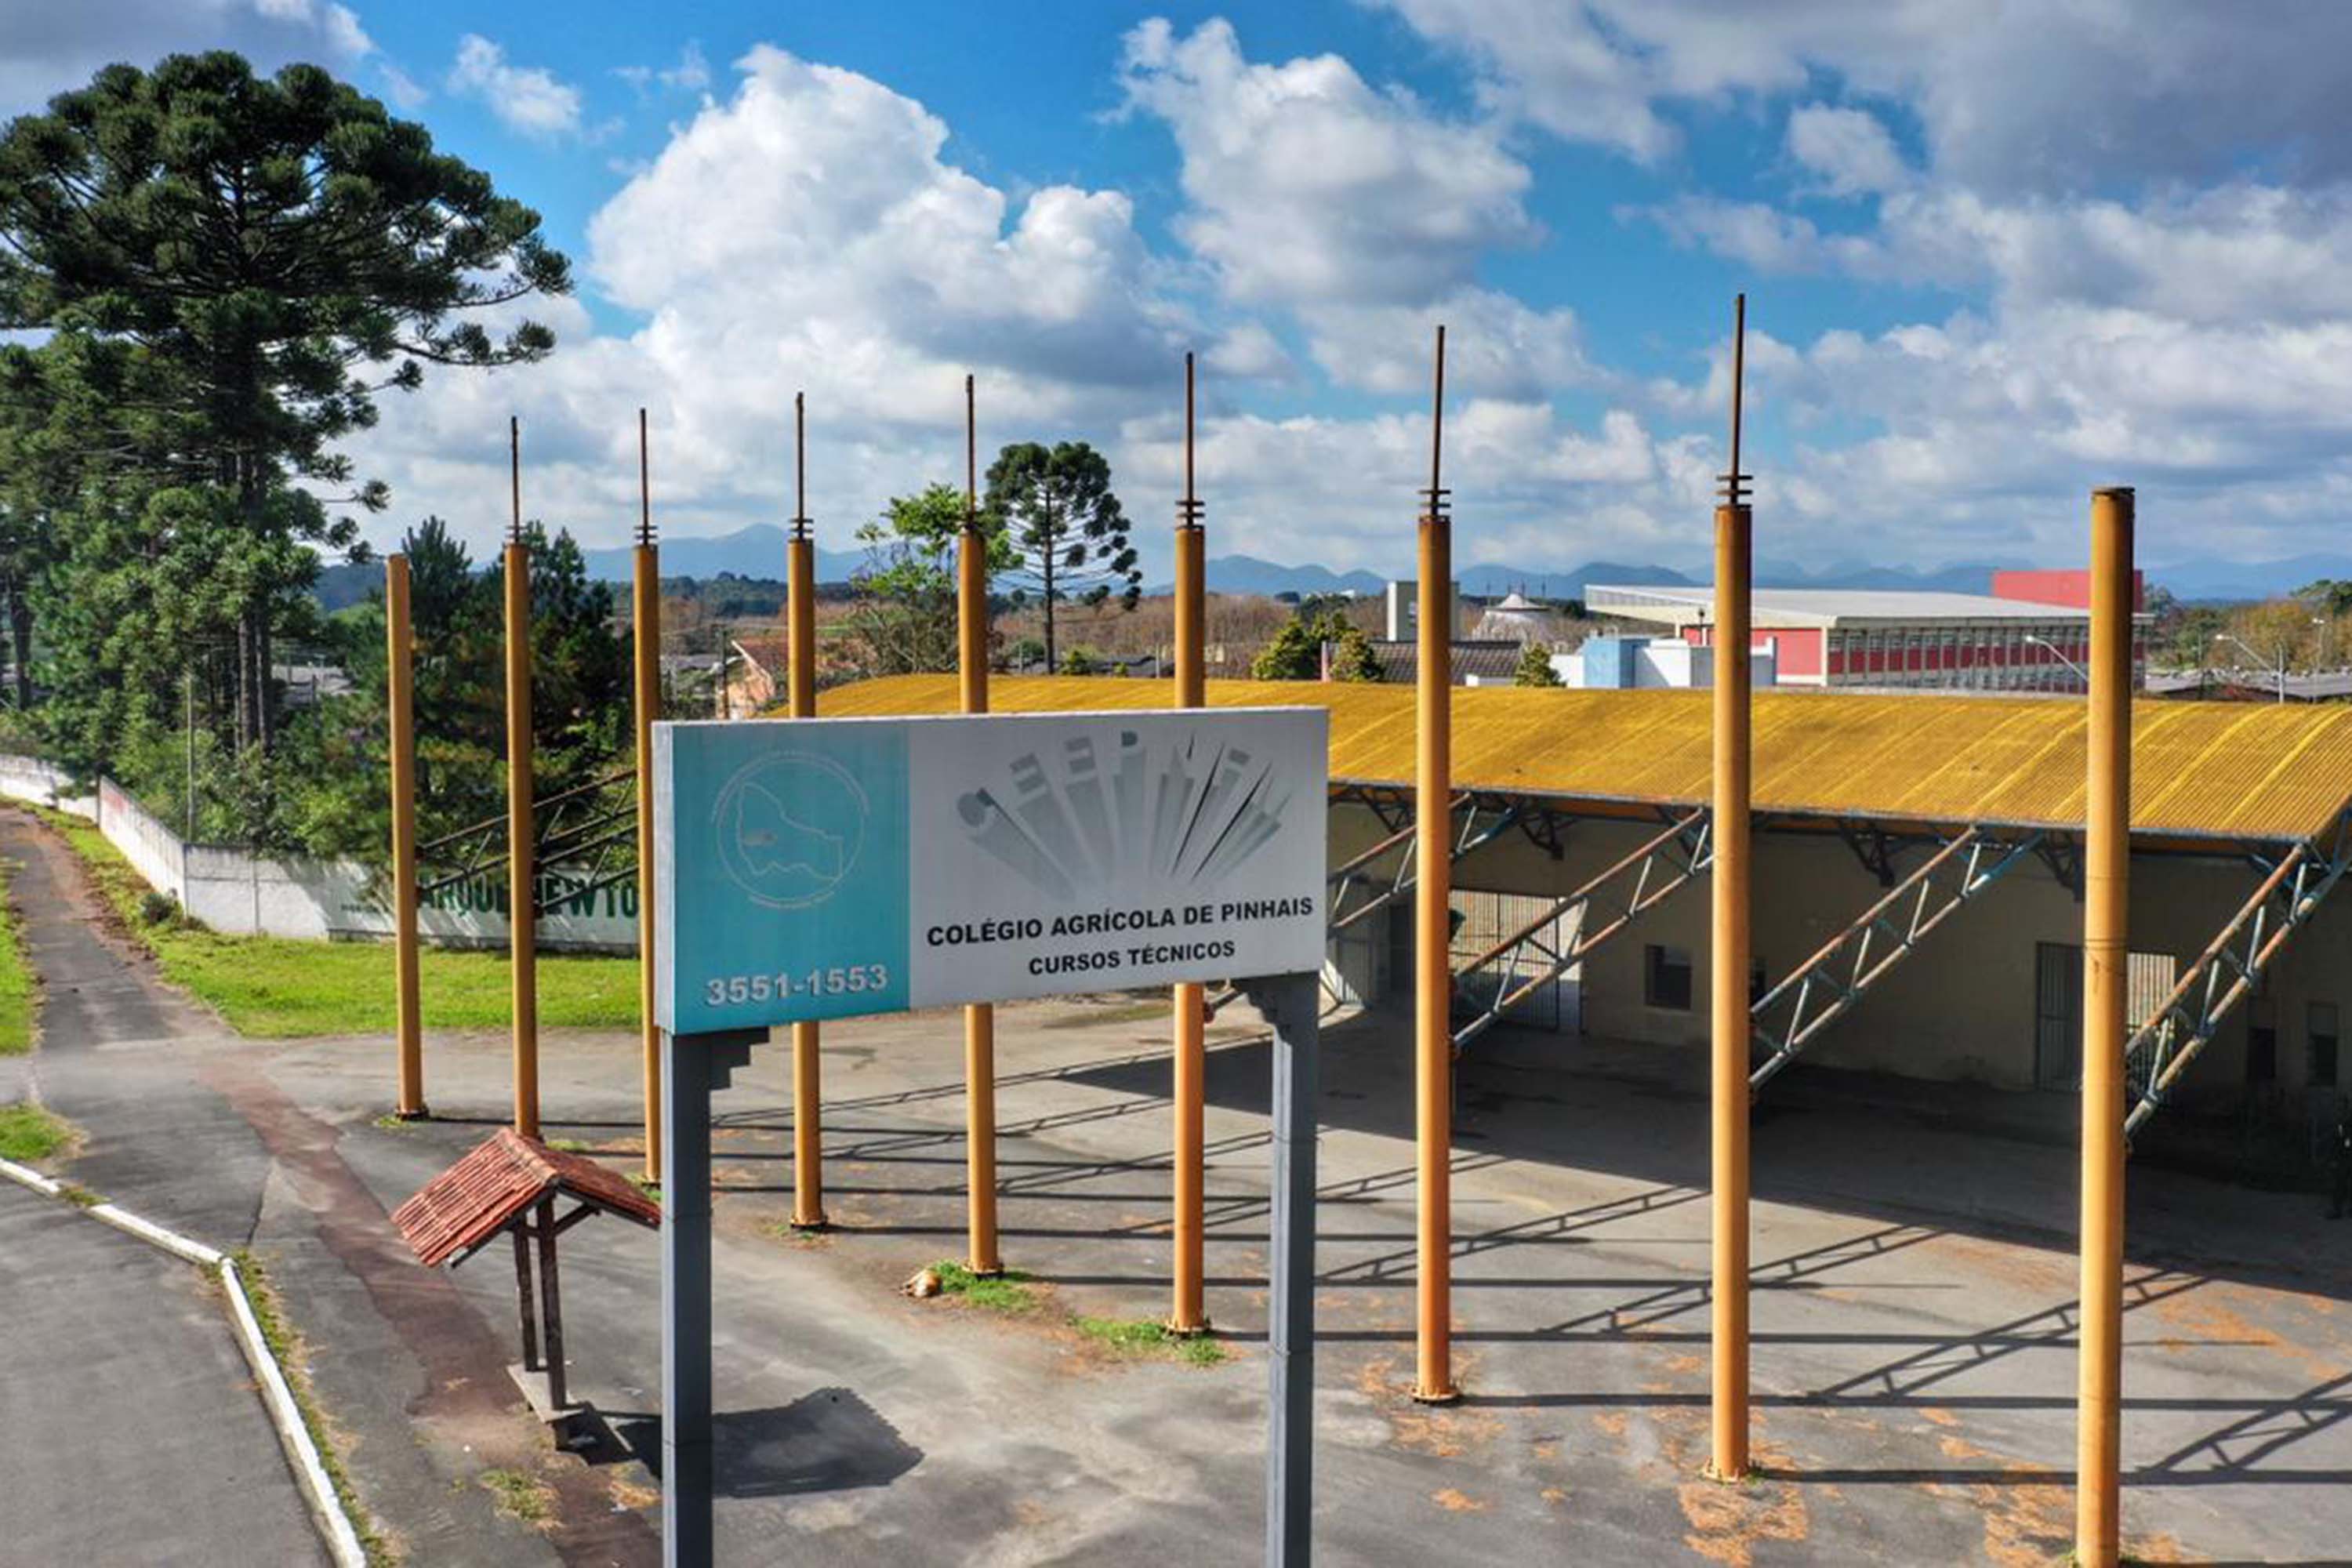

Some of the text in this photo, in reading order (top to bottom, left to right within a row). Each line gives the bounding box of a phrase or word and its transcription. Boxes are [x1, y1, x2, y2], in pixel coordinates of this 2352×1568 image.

[927, 897, 1314, 946] COLÉGIO AGRÍCOLA DE PINHAIS
[1029, 941, 1236, 976] CURSOS TÉCNICOS
[706, 964, 888, 1007] 3551-1553
